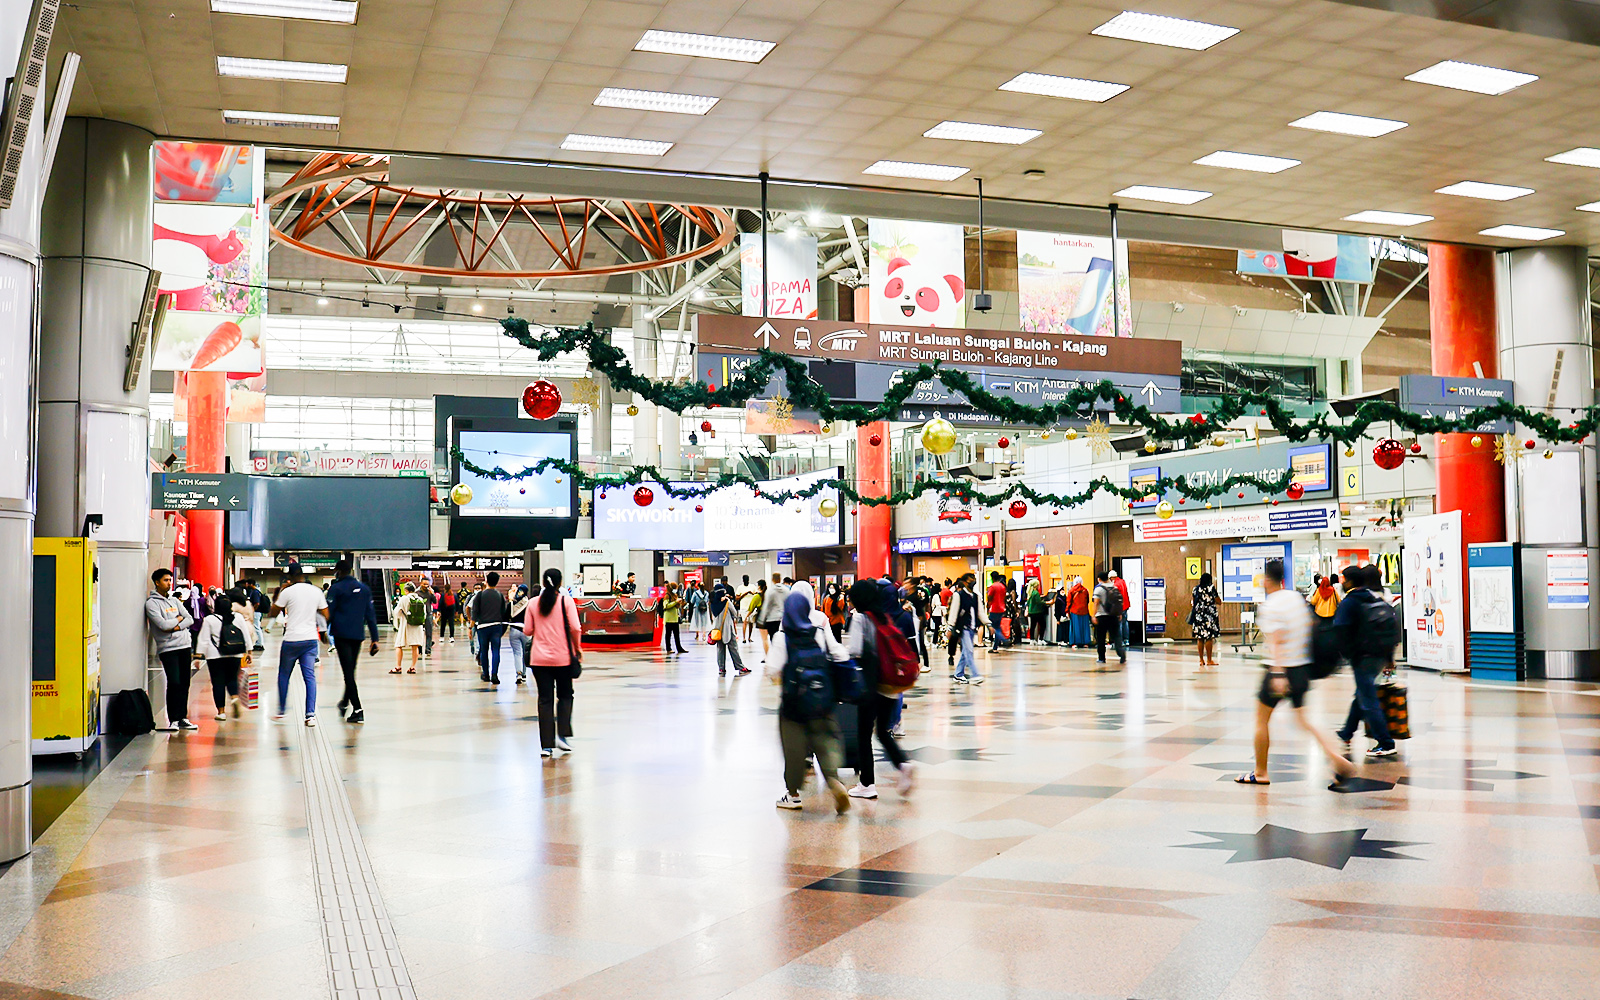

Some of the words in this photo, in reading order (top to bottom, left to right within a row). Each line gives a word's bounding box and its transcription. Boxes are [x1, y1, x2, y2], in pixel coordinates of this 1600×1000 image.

[1053, 237, 1095, 249] hantarkan.
[759, 296, 803, 316] PIZA
[830, 338, 858, 351] MRT
[879, 330, 911, 344] MRT
[914, 332, 961, 346] Laluan
[964, 334, 1010, 351] Sungai
[1013, 337, 1052, 351] Buloh
[1062, 340, 1108, 357] Kajang
[879, 345, 907, 359] MRT
[910, 347, 950, 361] Sungai
[952, 348, 984, 363] Buloh
[994, 351, 1032, 368] Kajang
[1035, 353, 1058, 367] Line
[1014, 380, 1039, 394] KTM
[1458, 386, 1475, 396] KTM
[1476, 387, 1504, 398] Komuter
[916, 391, 949, 402] タクシー
[948, 412, 956, 420] Di
[959, 412, 989, 422] Hadapan
[357, 457, 389, 470] MESTI
[178, 478, 193, 486] KTM
[1186, 468, 1218, 489] KTM
[1348, 473, 1356, 489] C
[606, 507, 693, 523] SKYWORTH
[731, 505, 776, 517] Jenama
[1190, 563, 1198, 576] C
